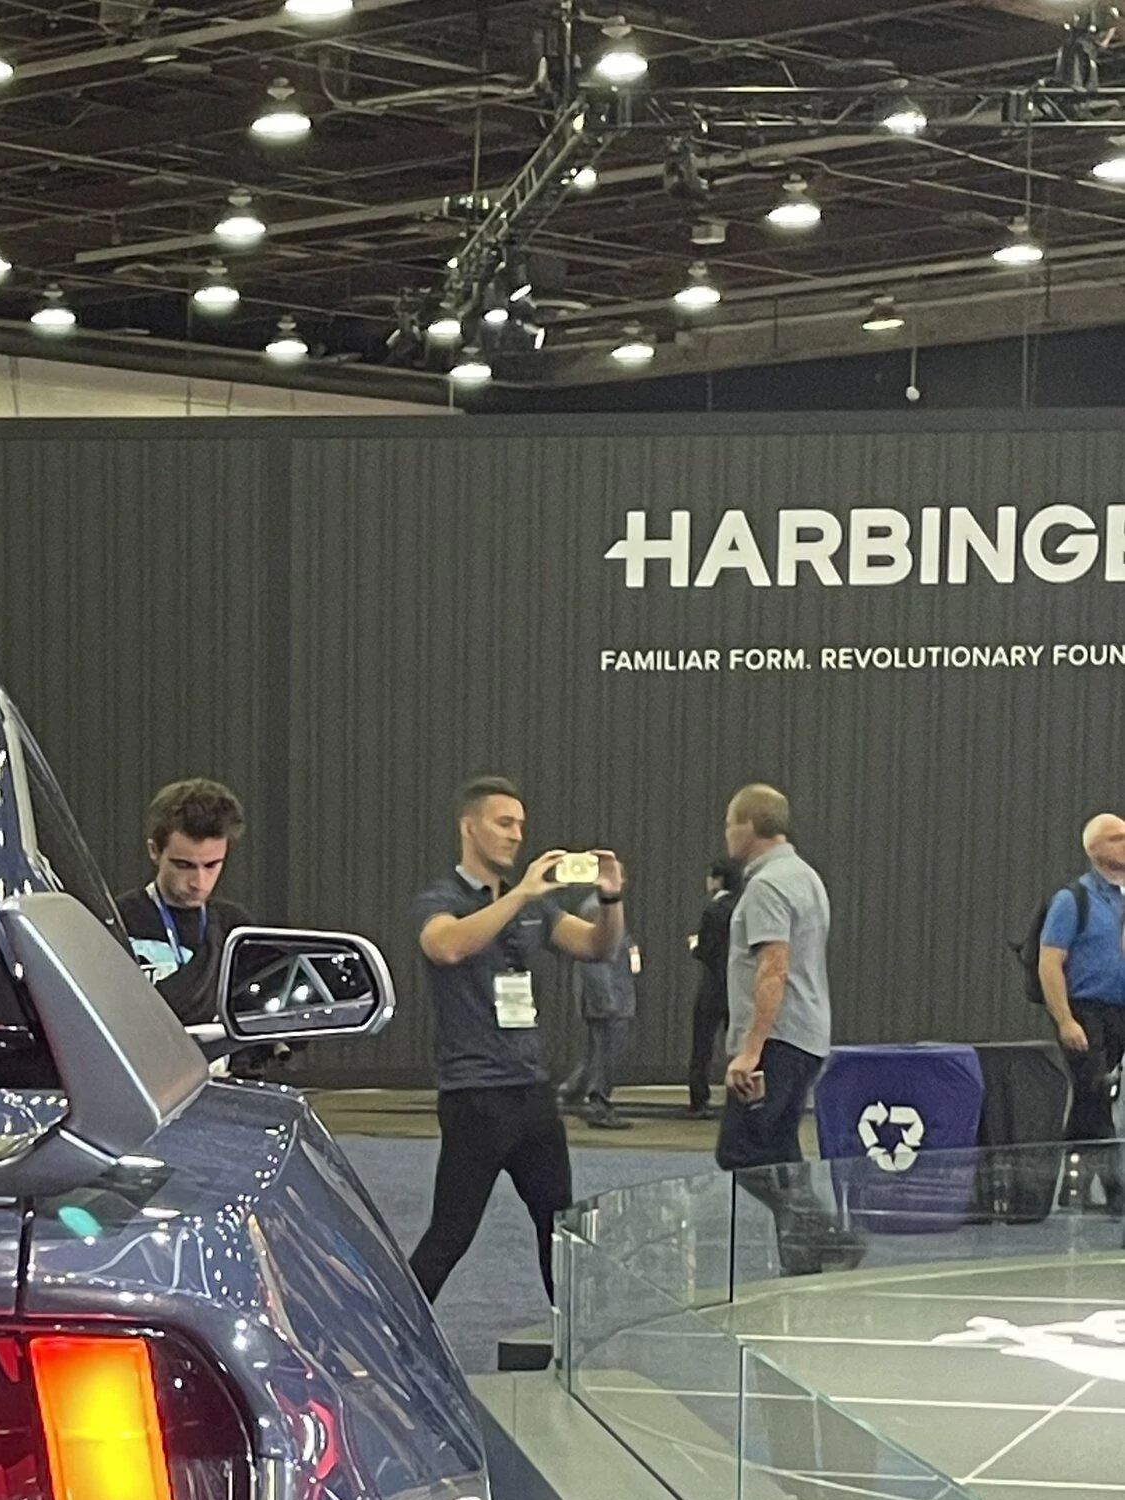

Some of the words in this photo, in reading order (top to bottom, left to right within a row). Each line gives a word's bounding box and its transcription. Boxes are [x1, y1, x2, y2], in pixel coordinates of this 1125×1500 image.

[600, 649, 721, 671] FAMILIAR
[729, 648, 812, 671] FORM.
[821, 645, 1044, 670] REVOLUTIONARY
